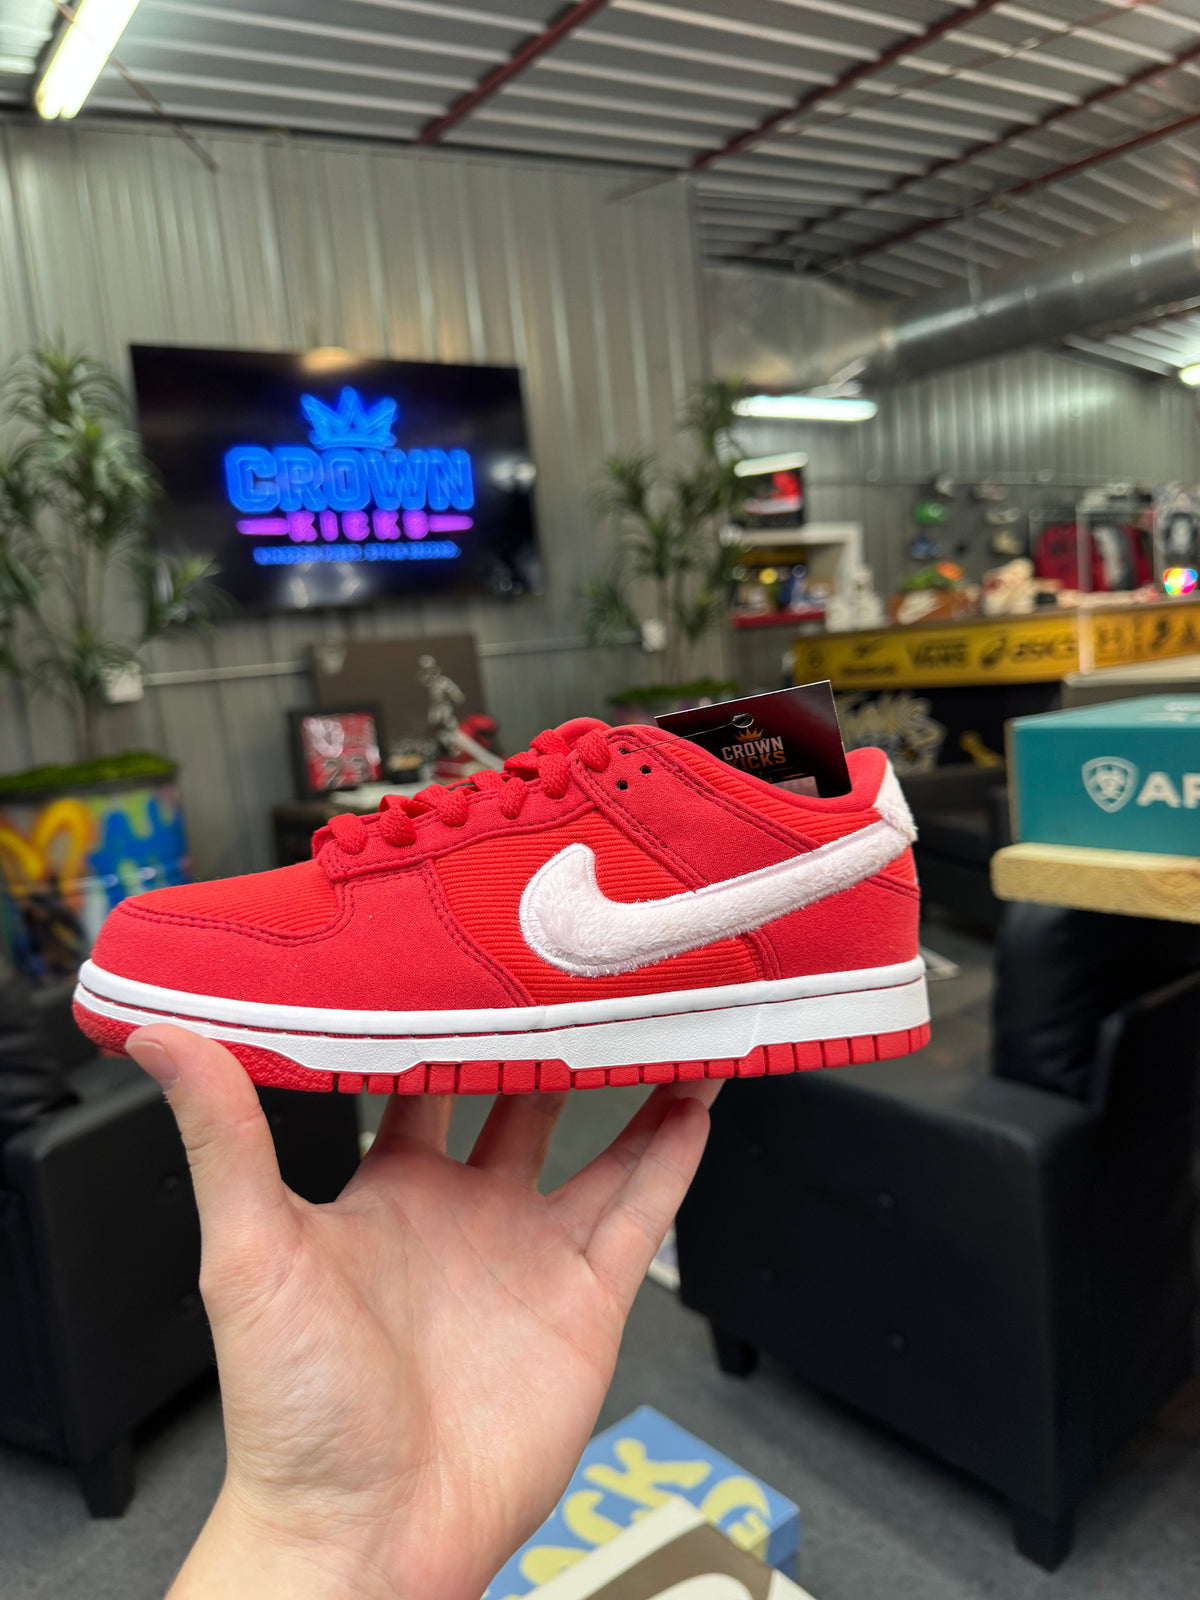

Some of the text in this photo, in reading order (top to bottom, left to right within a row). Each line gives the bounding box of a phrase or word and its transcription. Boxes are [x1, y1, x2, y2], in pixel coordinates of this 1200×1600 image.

[225, 446, 474, 512] CROWN
[286, 509, 429, 542] KICKS
[721, 736, 784, 761] CROWN
